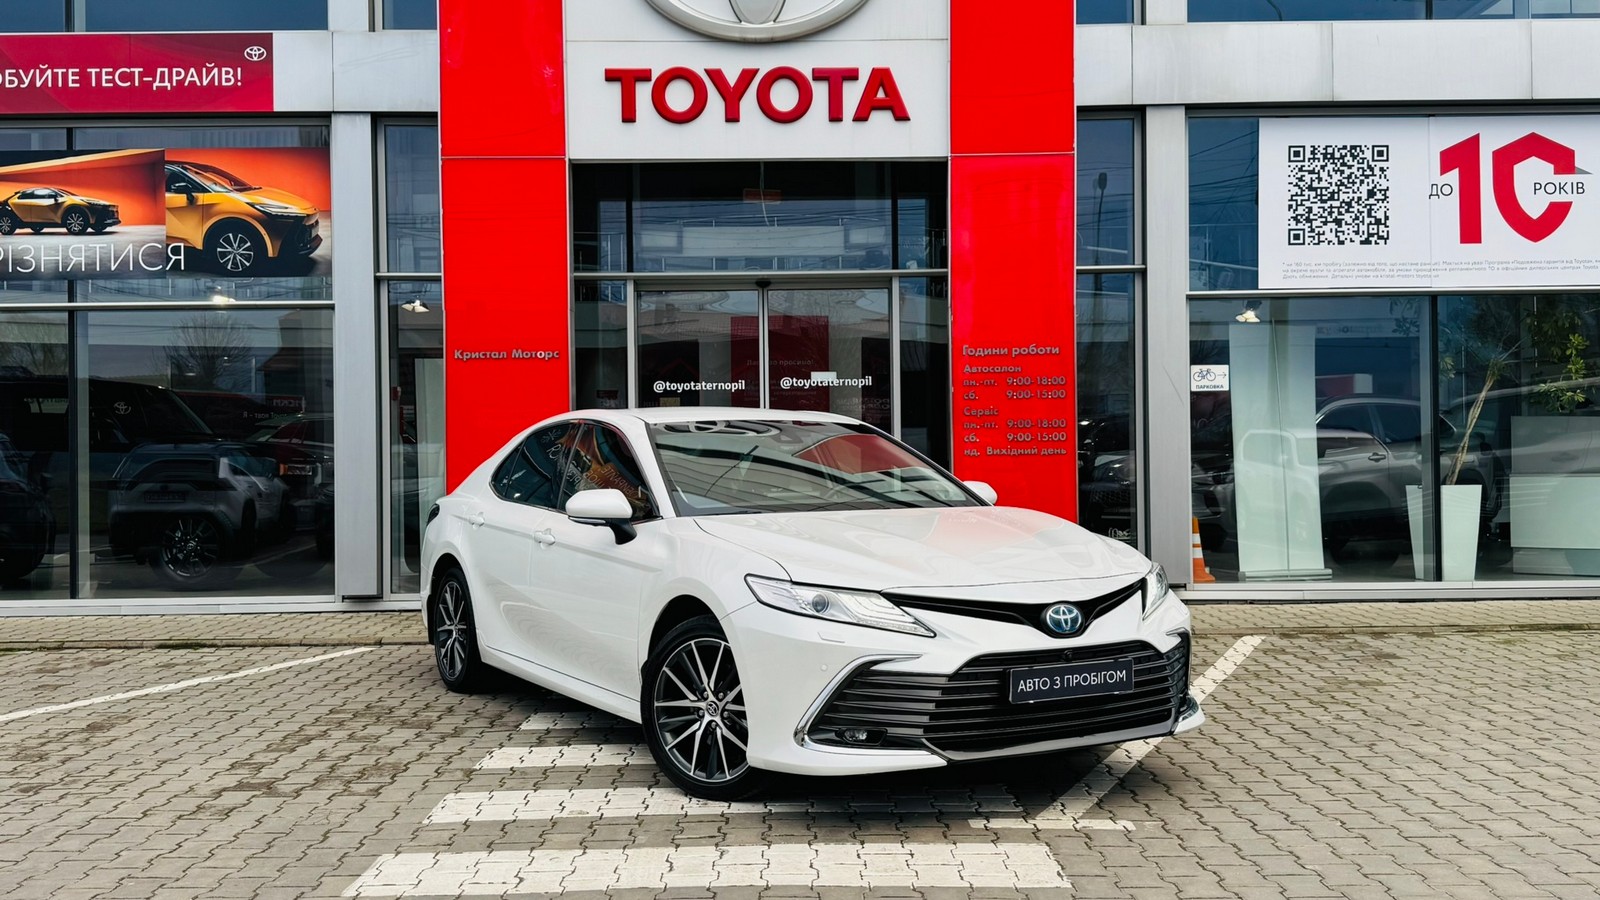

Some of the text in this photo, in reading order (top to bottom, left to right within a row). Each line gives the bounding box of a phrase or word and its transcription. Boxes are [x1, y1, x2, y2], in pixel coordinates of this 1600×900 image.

[0, 62, 242, 91] БУЙТЕ ТЕСТ-ДРАЙВ!
[604, 66, 911, 124] TOYOTA
[1428, 183, 1453, 199] ДО
[1533, 181, 1586, 196] РОКІВ
[0, 243, 185, 273] ІЗНЯТИСЯ
[454, 348, 559, 361] Кристал Моторс
[962, 344, 1060, 358] Години роботи
[963, 364, 1021, 373] Автосалон
[653, 379, 746, 393] @toyotaternopil
[780, 376, 873, 390] @toyotaternopil
[964, 391, 979, 400] сб.
[963, 405, 999, 417] Сервіс
[964, 433, 980, 442] сб.
[964, 445, 1067, 456] нд. Вихідний день
[1017, 676, 1050, 693] АВТО
[1064, 669, 1127, 689] ПРОБІГОМ
